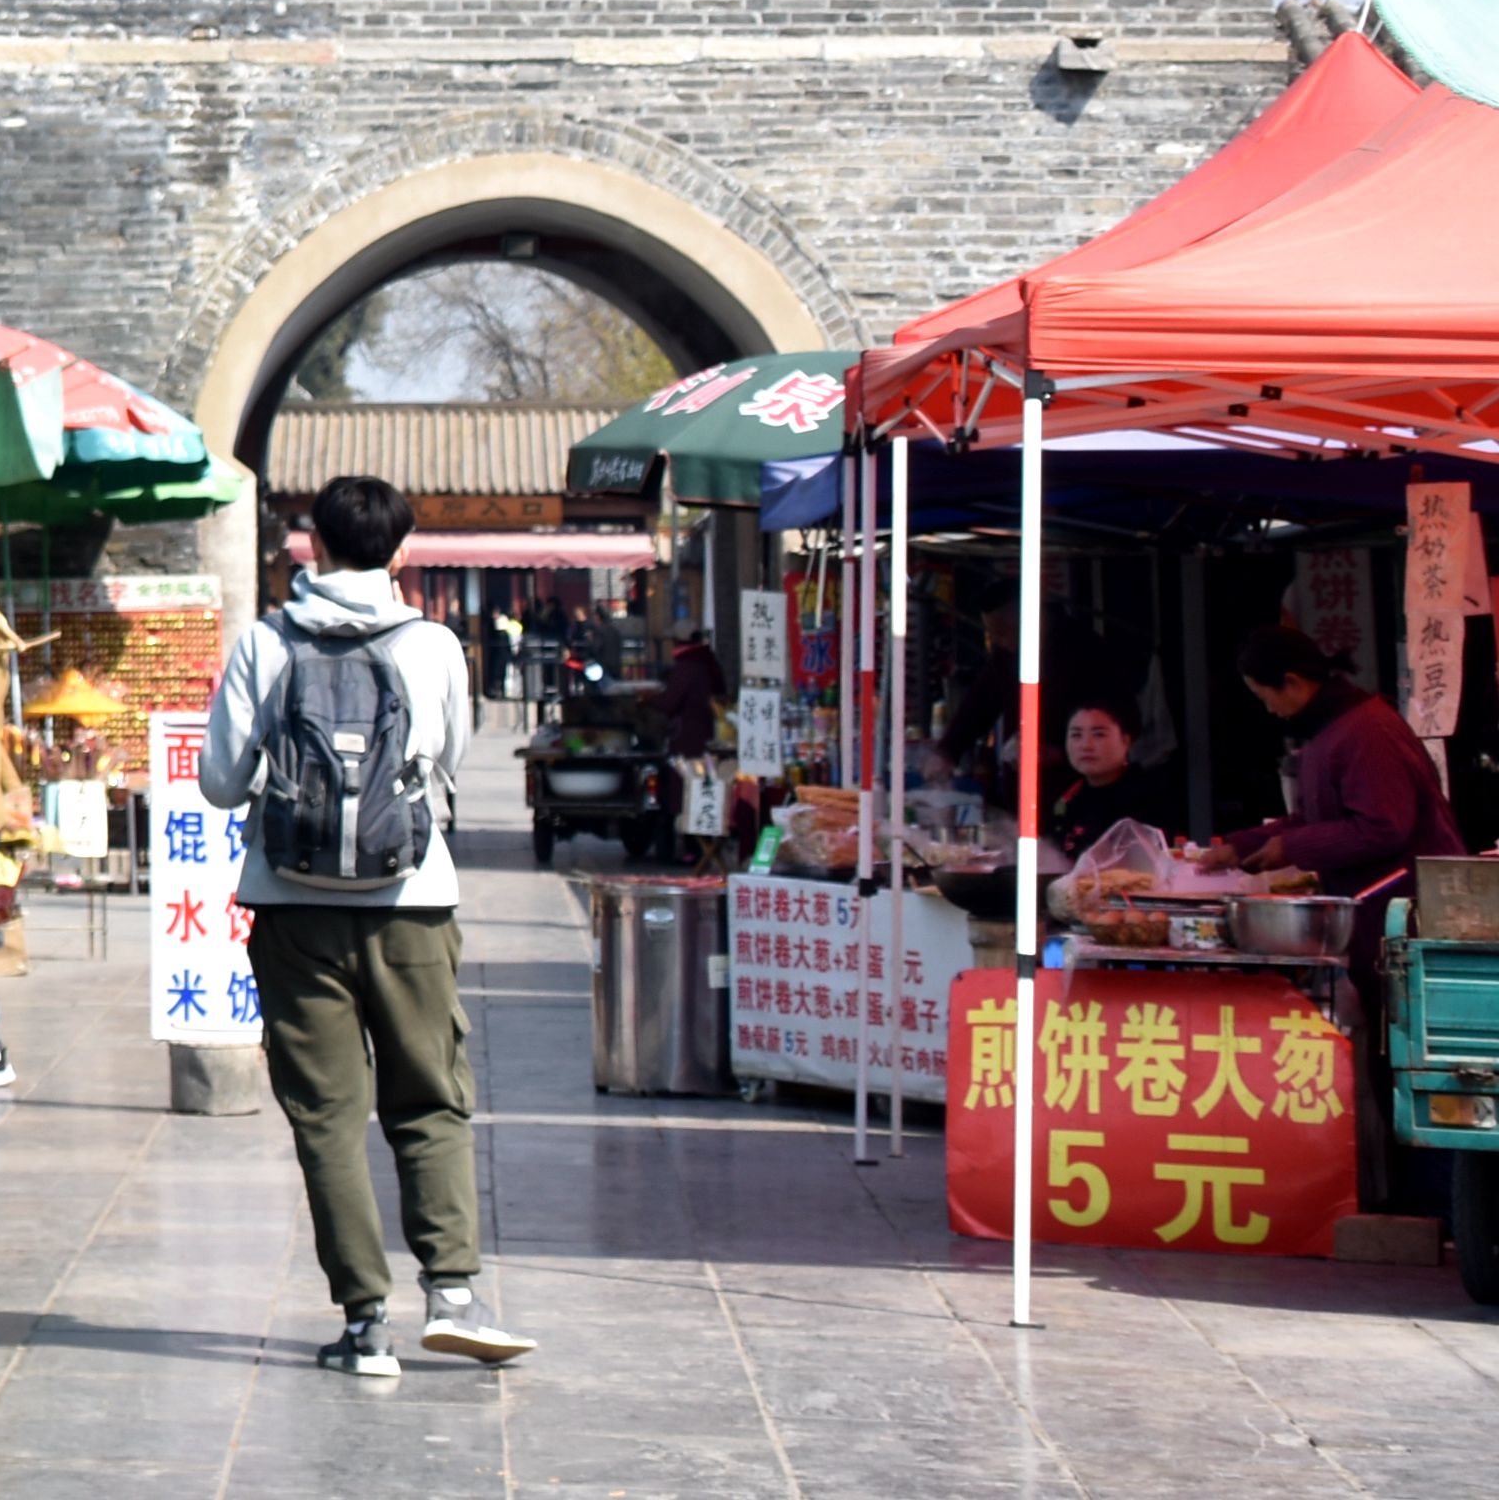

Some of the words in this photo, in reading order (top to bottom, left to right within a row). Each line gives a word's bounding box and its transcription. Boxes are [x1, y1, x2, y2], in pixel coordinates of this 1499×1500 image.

[416, 498, 543, 517] 府入口
[1415, 494, 1450, 599] 热奶茶
[1418, 616, 1451, 736] 热豆浆
[164, 732, 205, 784] 面
[167, 969, 263, 1023] 米饭
[964, 997, 1345, 1127] 煎饼卷大葱
[1047, 1129, 1271, 1245] 5元
